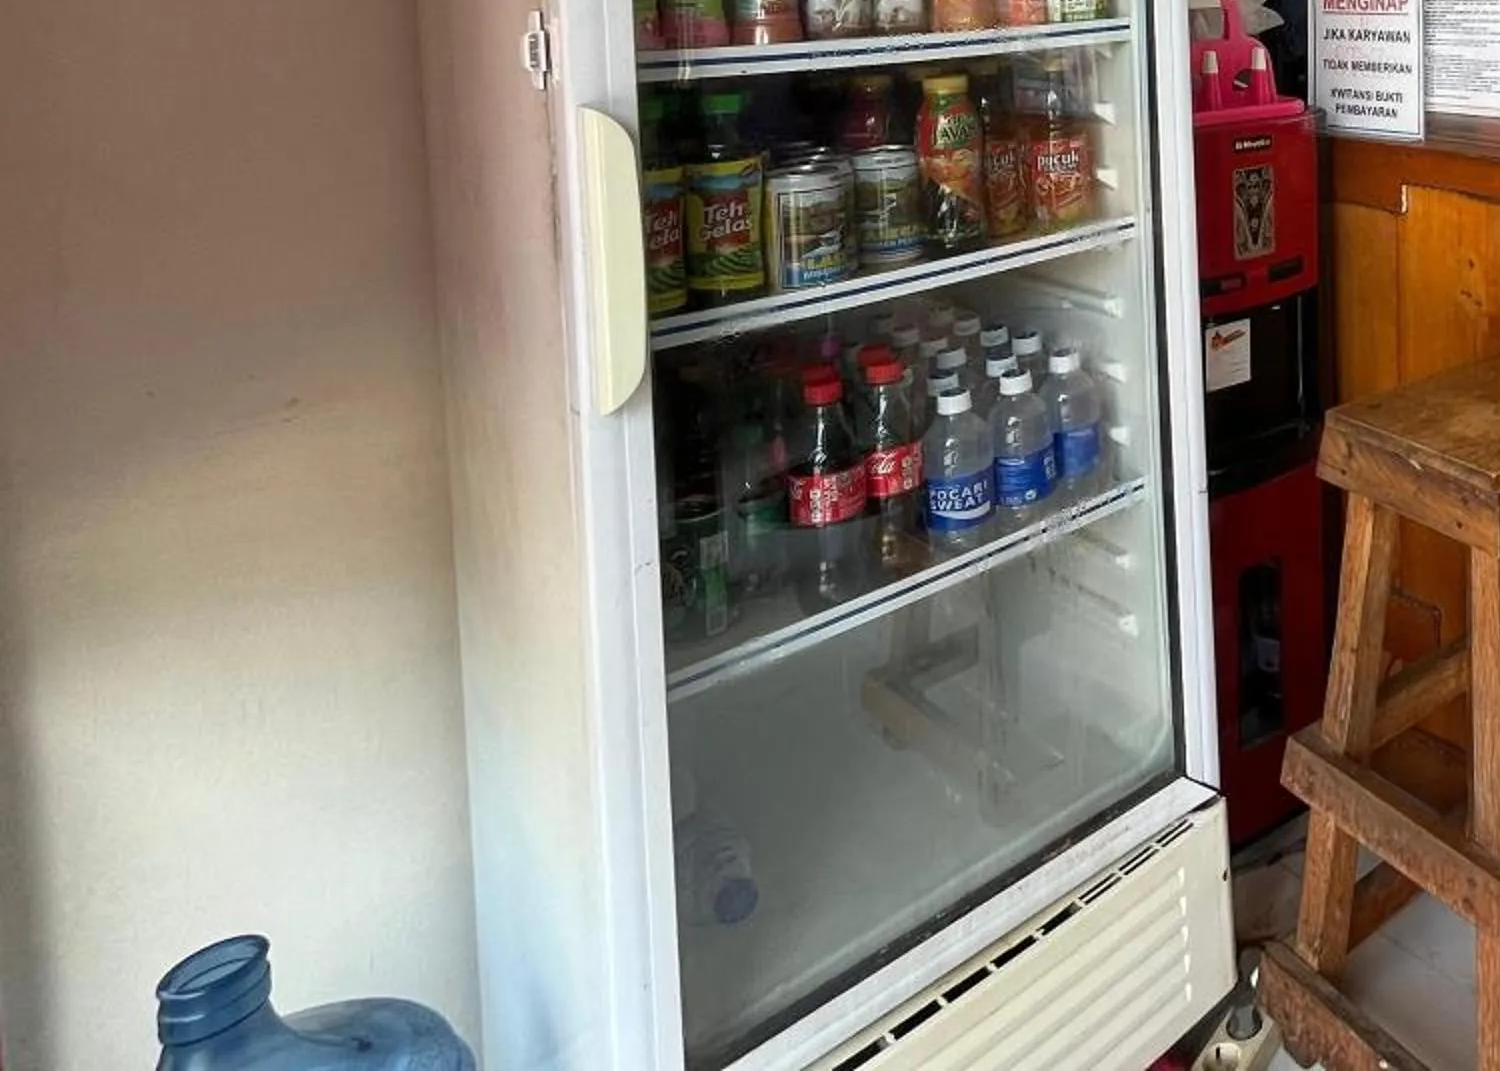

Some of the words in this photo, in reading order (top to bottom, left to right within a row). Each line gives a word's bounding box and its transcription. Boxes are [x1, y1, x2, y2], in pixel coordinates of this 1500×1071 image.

[1348, 28, 1411, 44] KARYAWAN
[1322, 58, 1349, 70] TIDAK
[1351, 60, 1413, 74] MEMBERIKAN
[1375, 90, 1404, 103] BUKTI
[1335, 103, 1398, 118] PEMBAYARAN
[704, 201, 744, 224] Teh
[929, 480, 988, 500] POCARI
[929, 494, 983, 510] SWEAT
